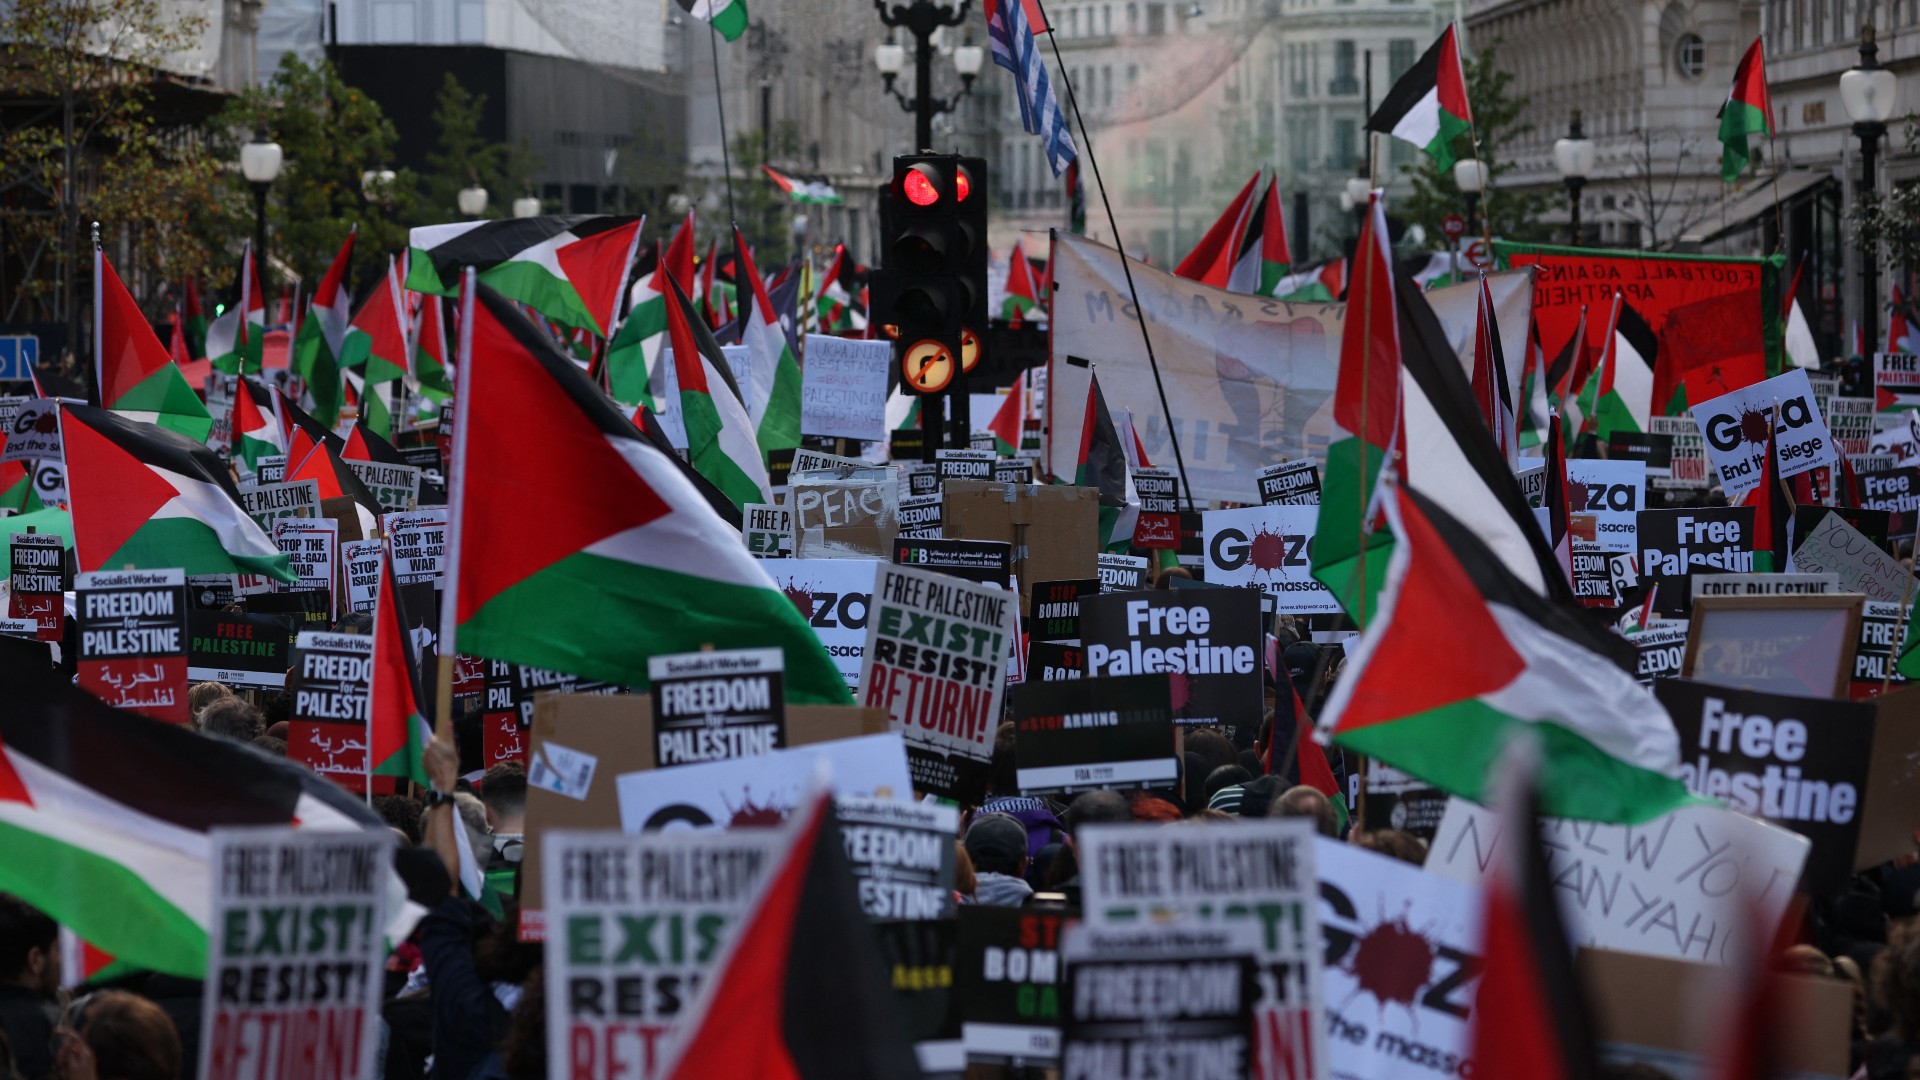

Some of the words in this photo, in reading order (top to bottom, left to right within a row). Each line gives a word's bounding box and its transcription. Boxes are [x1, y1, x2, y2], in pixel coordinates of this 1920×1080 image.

[1883, 354, 1919, 371] FREE
[27, 439, 46, 451] the
[941, 461, 990, 478] FREEDOM
[1720, 459, 1752, 482] End
[1752, 455, 1766, 472] th
[1779, 437, 1822, 462] siege
[262, 466, 285, 480] FREE
[364, 466, 415, 488] PALESTINE
[1263, 470, 1314, 495] FREEDOM
[1134, 478, 1173, 493] FREEDOM
[1864, 475, 1910, 497] Free
[256, 485, 314, 512] PALESTINE
[750, 508, 778, 530] FREE
[797, 487, 882, 532] PEAC
[398, 517, 434, 525] Socialist
[1599, 523, 1636, 533] sacre
[1677, 515, 1741, 545] Free
[278, 539, 302, 552] STOP
[305, 538, 324, 551] THE
[393, 533, 420, 547] STOP
[425, 531, 443, 544] THE
[1819, 517, 1867, 556] YOU
[14, 549, 59, 567] FREEDOM
[409, 558, 435, 571] WAR
[900, 547, 928, 564] PFB
[1112, 556, 1137, 567] Worker
[1574, 555, 1606, 572] EEDOM
[350, 560, 378, 575] STOP
[12, 575, 62, 592] PALESTINE
[90, 576, 133, 587] Socialist
[132, 574, 168, 586] Worker
[295, 579, 328, 588] SOCIALIST
[1271, 581, 1331, 593] massac
[1574, 579, 1611, 597] LESTINE
[883, 572, 924, 607] FREE
[924, 581, 1008, 629] PALESTINE
[1050, 585, 1077, 601] STOP
[85, 590, 175, 618] FREEDOM
[1039, 601, 1081, 619] BOMBIN
[122, 616, 140, 630] for
[305, 610, 328, 622] Aqsa
[1127, 600, 1210, 636] Free
[216, 623, 254, 639] FREE
[877, 606, 1003, 663] EXIST!
[1047, 619, 1074, 634] GAZA
[82, 628, 181, 656] PALESTINE
[192, 637, 276, 657] PALESTINE
[311, 637, 354, 649] Socialist
[873, 637, 998, 690] RESIST!
[1088, 638, 1255, 678] Palestine
[100, 663, 165, 689] الحرية
[303, 653, 372, 684] FREEDO
[340, 682, 356, 694] for
[661, 676, 771, 717] FREEDOM
[296, 690, 372, 721] PALESTI
[866, 663, 993, 744] RETURN!
[1699, 696, 1809, 762] Free
[658, 724, 779, 765] PALESTINE
[909, 756, 956, 775] ALESTINE
[912, 774, 951, 790] MPAIGN
[1680, 753, 1858, 824] alestine
[221, 843, 271, 897] FREE
[277, 842, 381, 896] PALESTINE
[562, 847, 628, 904] FREE
[224, 905, 373, 958] EXIST!
[565, 912, 727, 967] EXIS
[218, 962, 369, 1003] RESIST!
[892, 964, 952, 991] Aqsa
